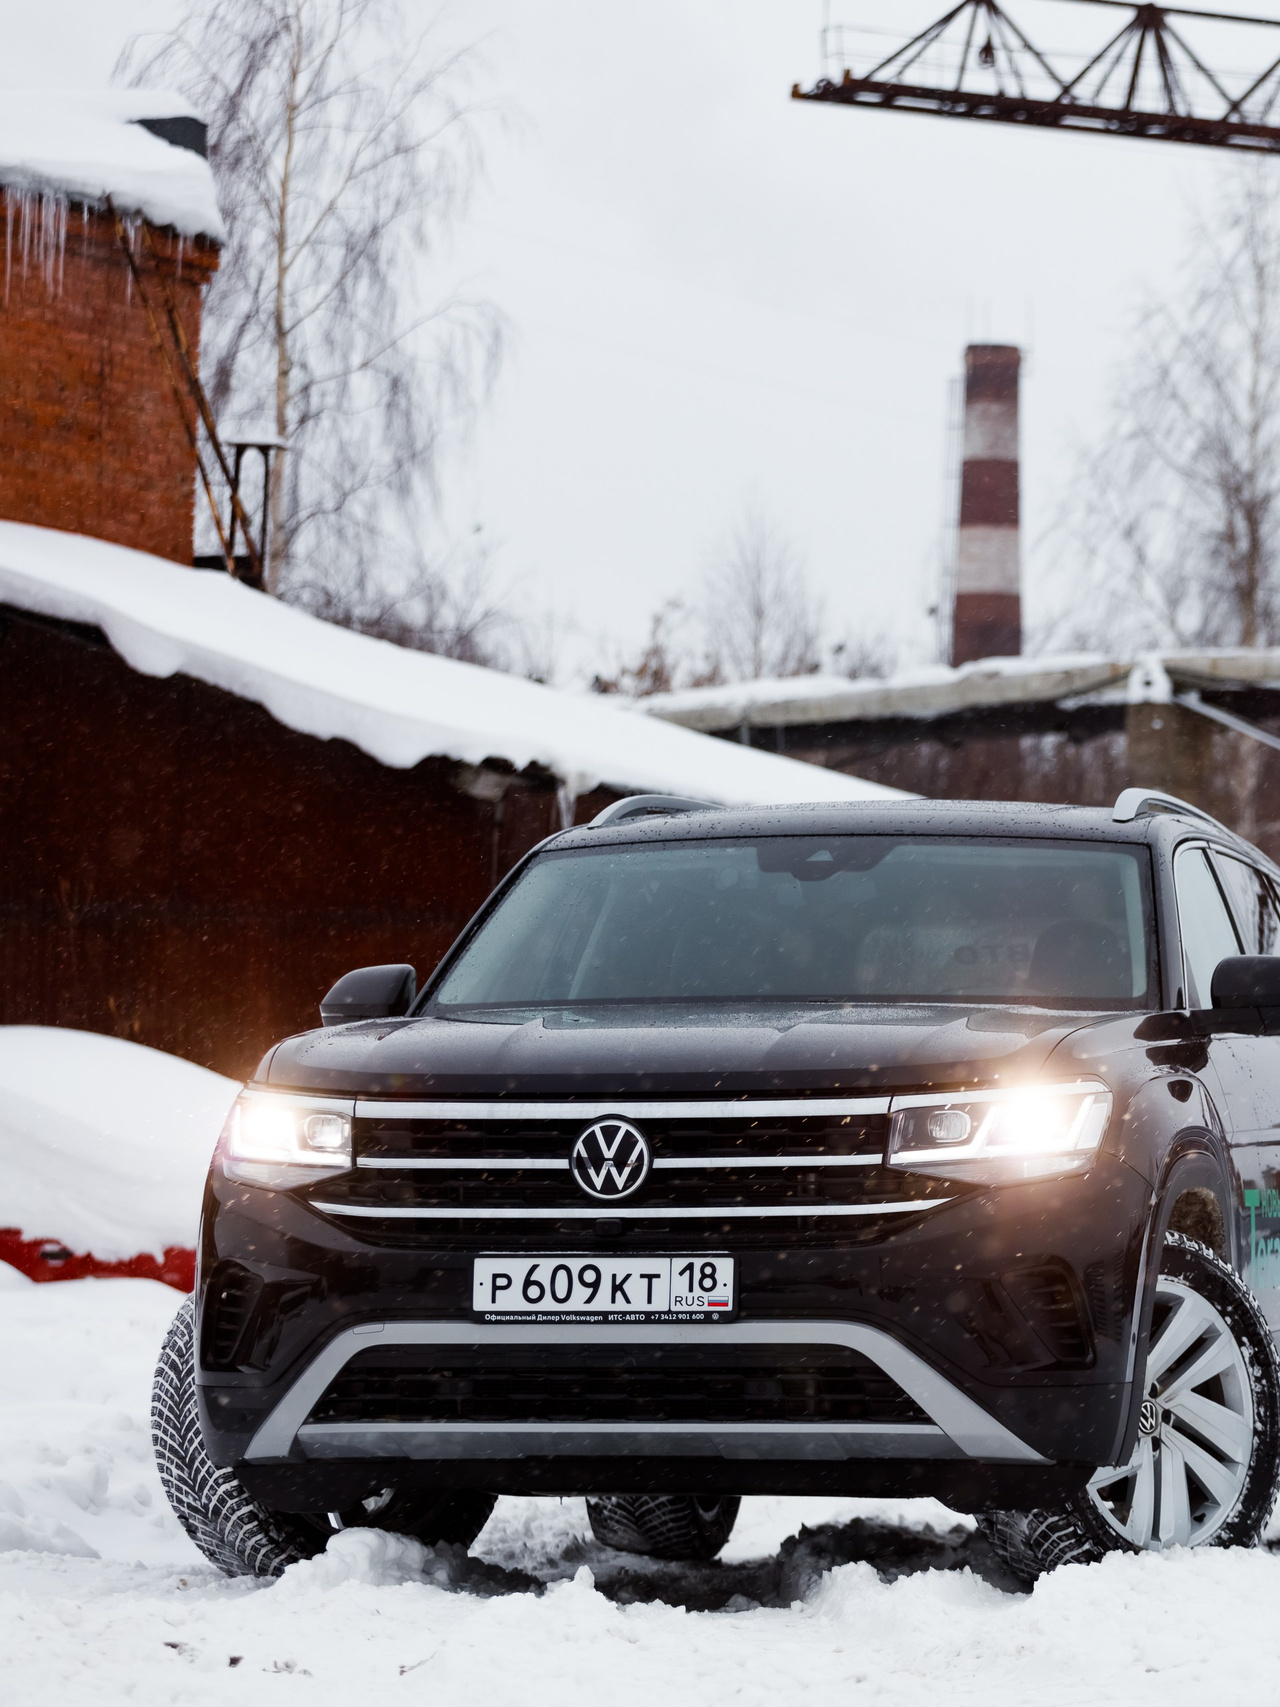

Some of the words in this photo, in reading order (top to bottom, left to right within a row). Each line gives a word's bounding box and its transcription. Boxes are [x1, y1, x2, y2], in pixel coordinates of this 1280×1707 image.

[677, 1261, 718, 1293] 18
[674, 1295, 705, 1307] RUS
[484, 1313, 536, 1322] Официальный
[536, 1313, 560, 1323] Дилер
[561, 1313, 603, 1323] Volkswagen
[608, 1313, 646, 1321] ИТС-АВТО
